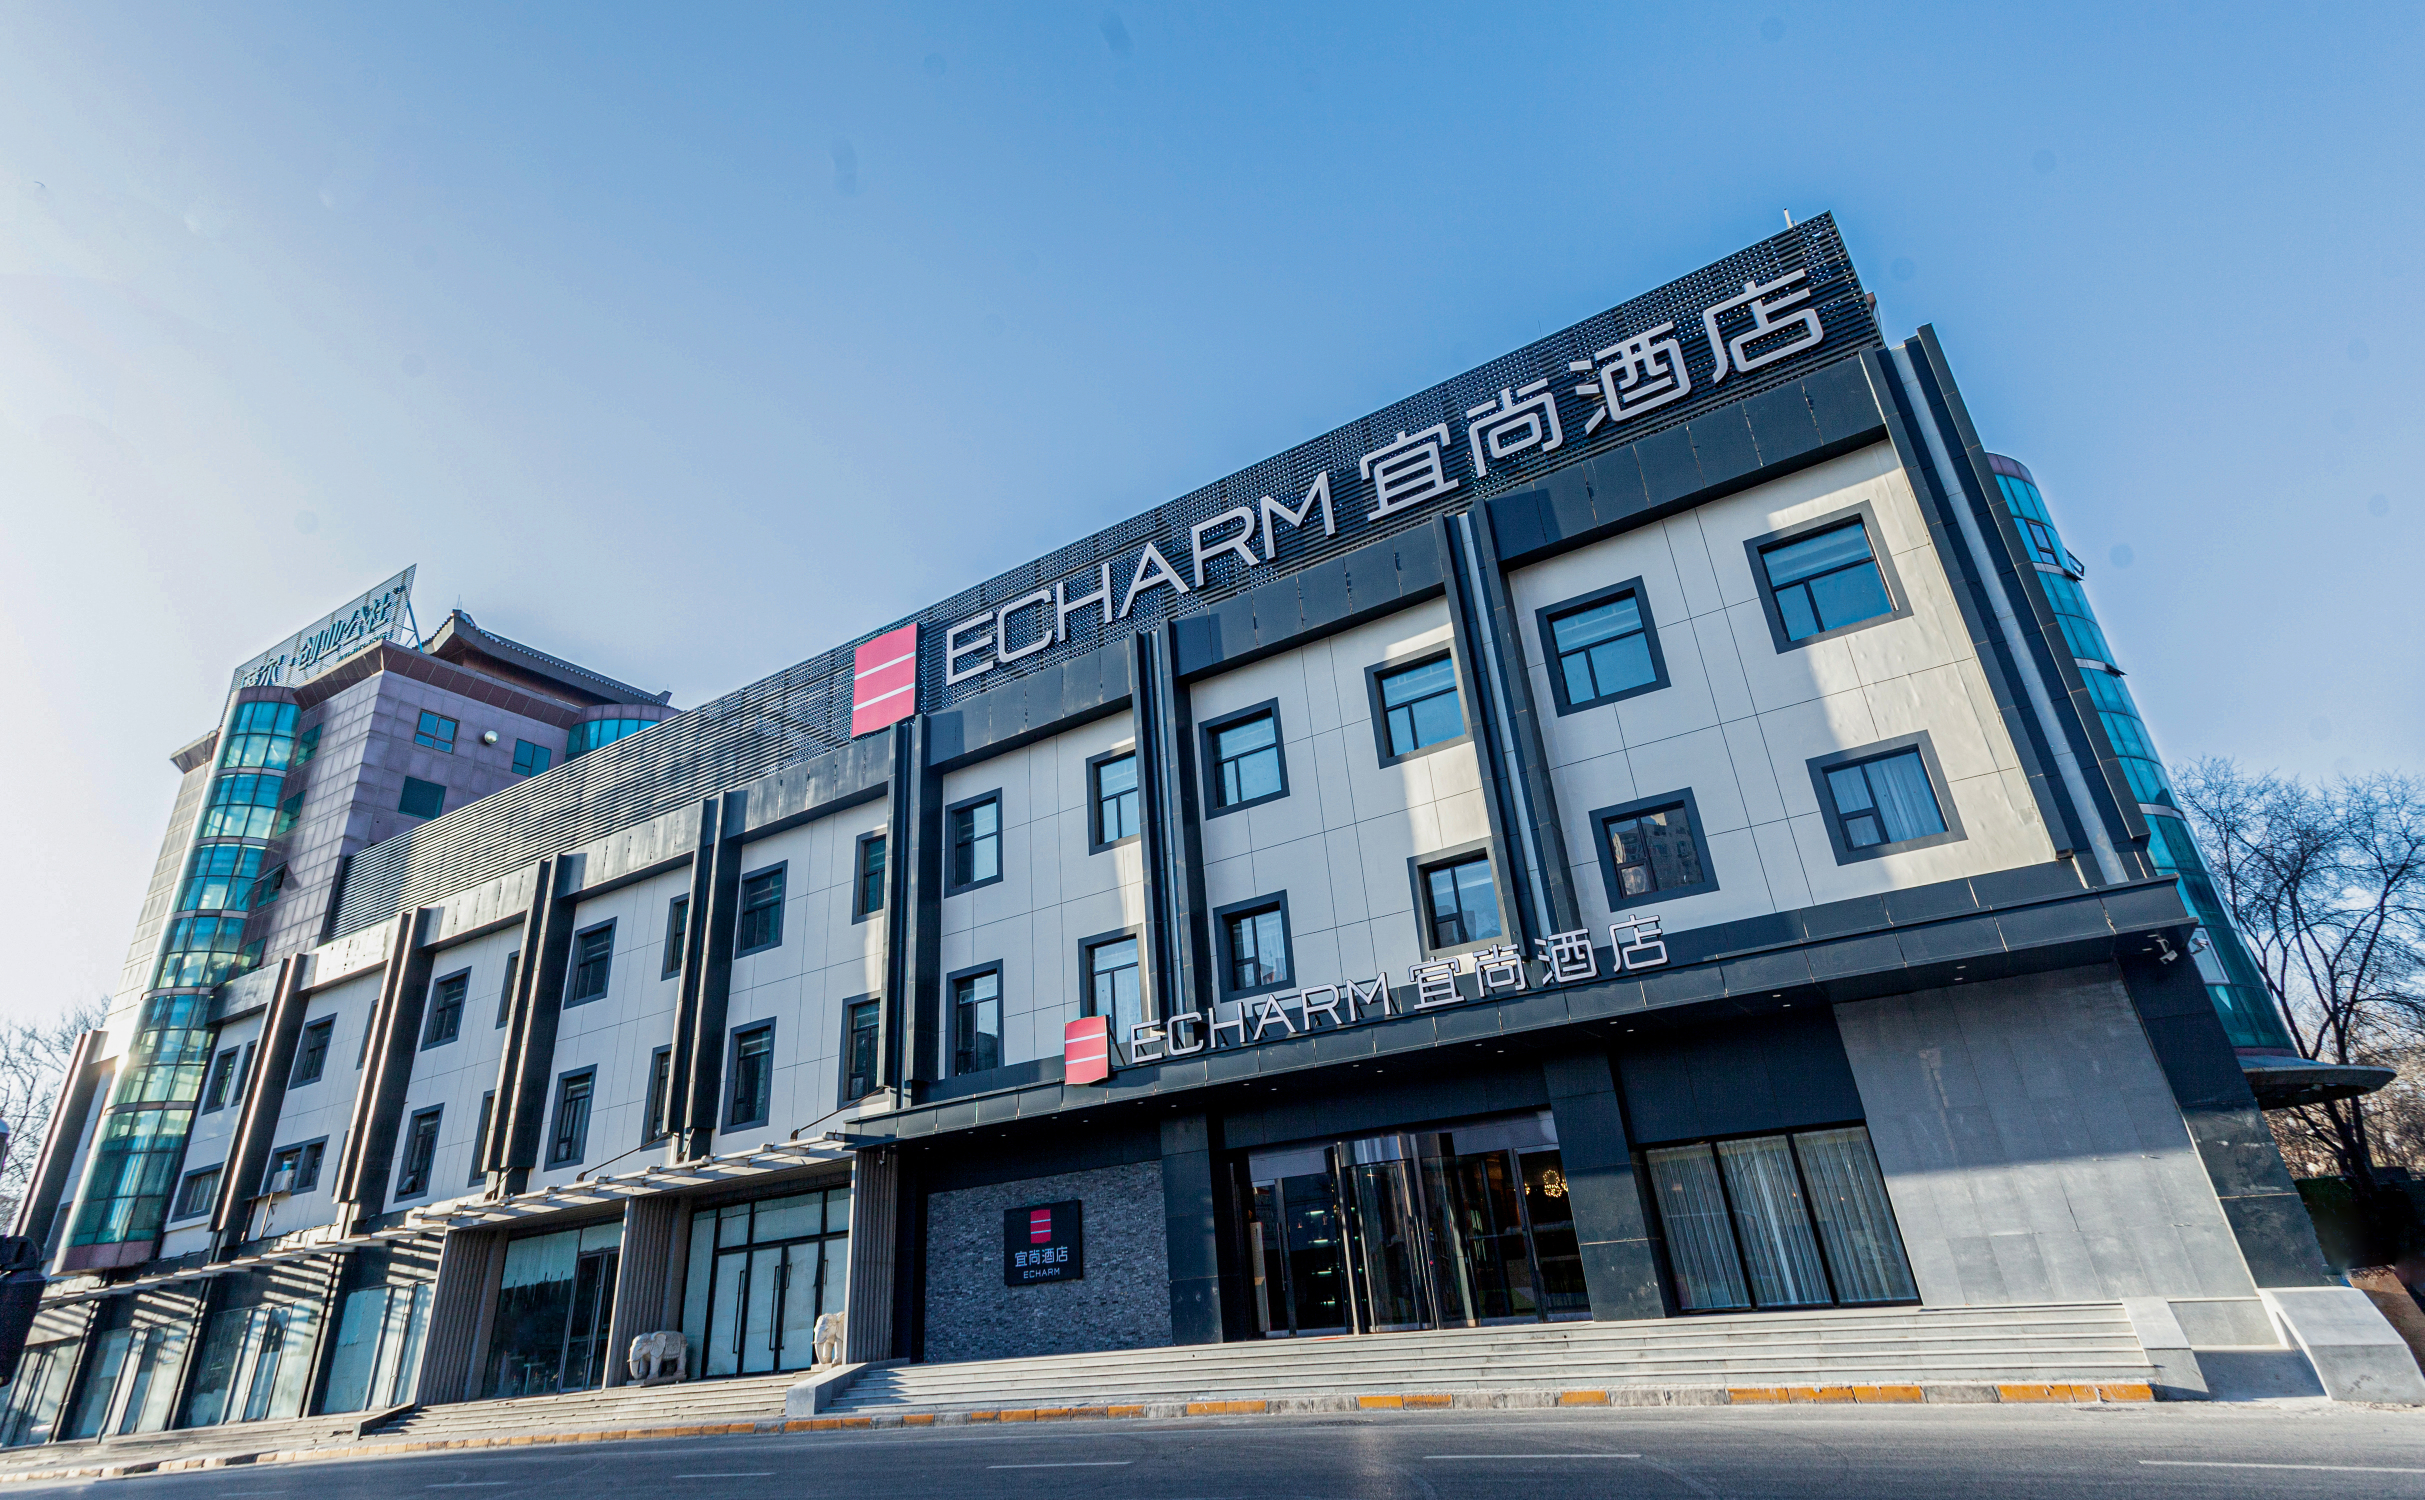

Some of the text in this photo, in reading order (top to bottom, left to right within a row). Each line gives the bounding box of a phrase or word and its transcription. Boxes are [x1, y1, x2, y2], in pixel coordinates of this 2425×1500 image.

[946, 269, 1825, 685] ECHARM 宜尚酒店
[1130, 914, 1669, 1063] ECHARM 宜尚酒店
[1014, 1246, 1068, 1267] 宜尚酒店
[1023, 1267, 1060, 1279] ECHARM
